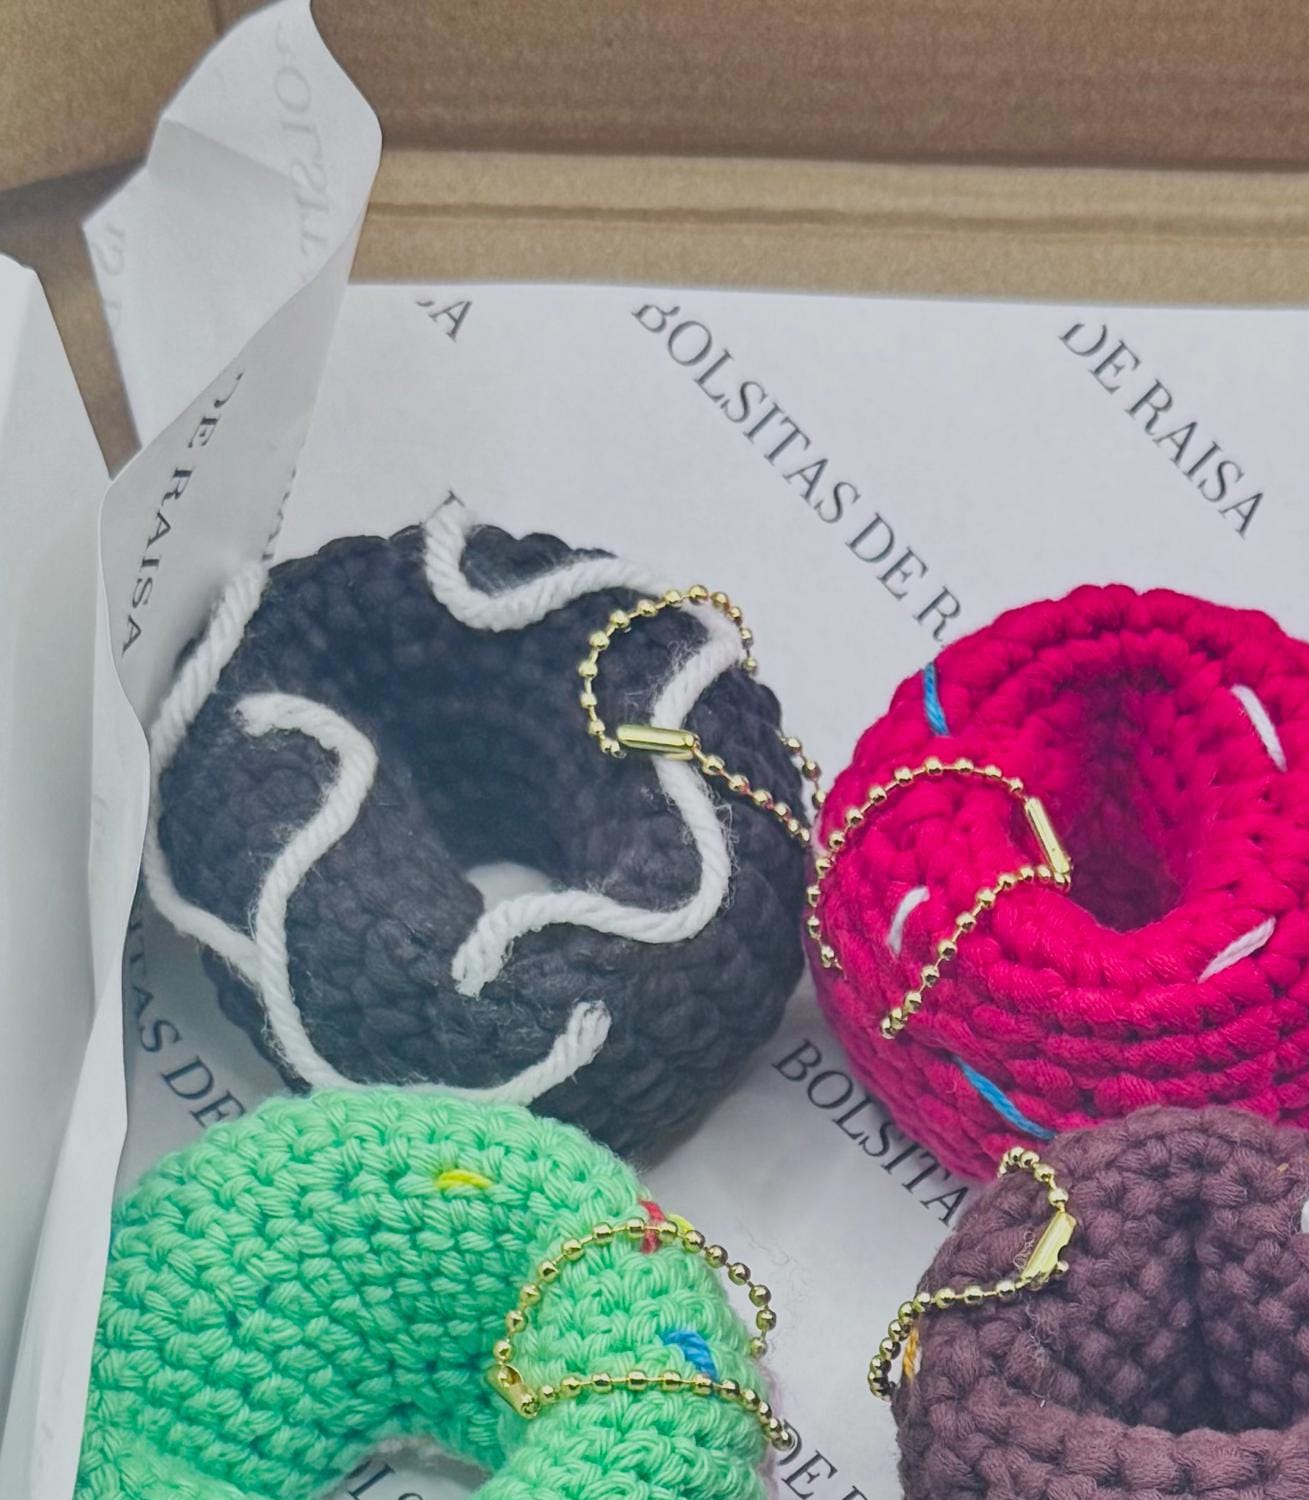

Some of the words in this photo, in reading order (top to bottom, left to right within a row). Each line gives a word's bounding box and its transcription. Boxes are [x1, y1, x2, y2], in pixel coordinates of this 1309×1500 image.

[1125, 379, 1265, 539] RAISA
[119, 463, 198, 658] RAISA
[846, 512, 928, 600] DE
